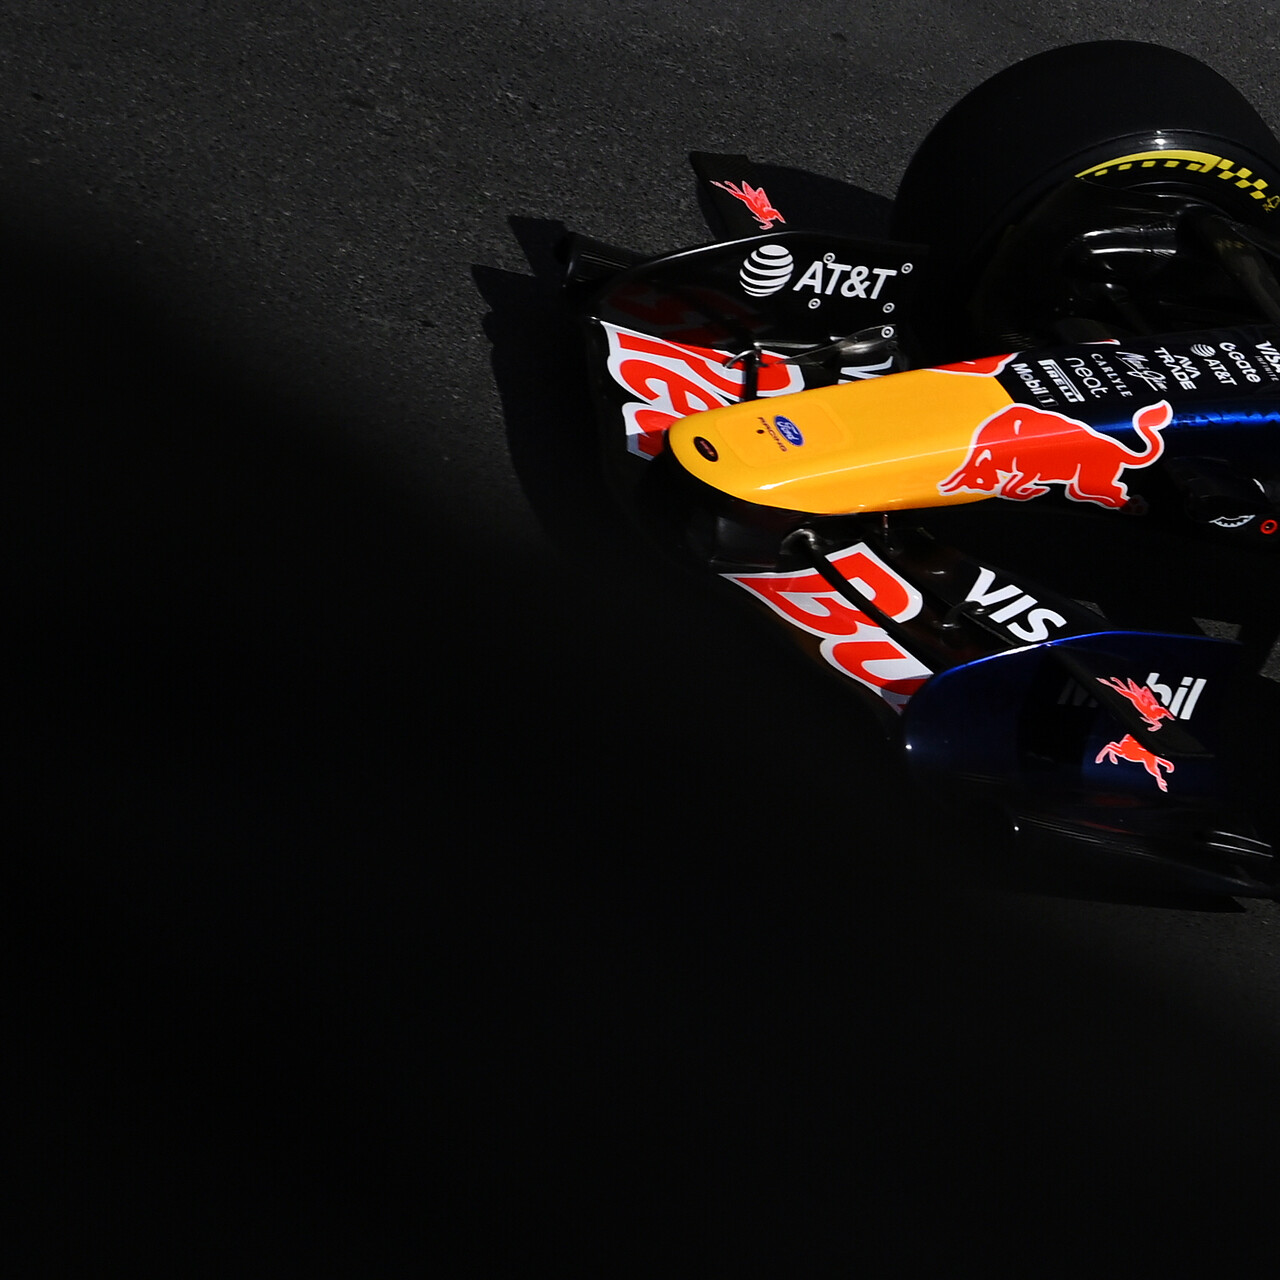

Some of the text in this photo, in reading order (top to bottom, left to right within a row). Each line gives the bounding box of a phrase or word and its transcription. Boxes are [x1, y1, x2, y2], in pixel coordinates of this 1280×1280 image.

[792, 260, 898, 300] AT&T
[1011, 362, 1050, 396] Mobil
[1037, 358, 1086, 402] PIRELLI
[1090, 353, 1134, 398] CARLYLE
[1154, 346, 1198, 391] TRADE
[1203, 358, 1239, 386] AT&T
[1228, 351, 1262, 384] Gate
[964, 565, 1068, 644] VIS
